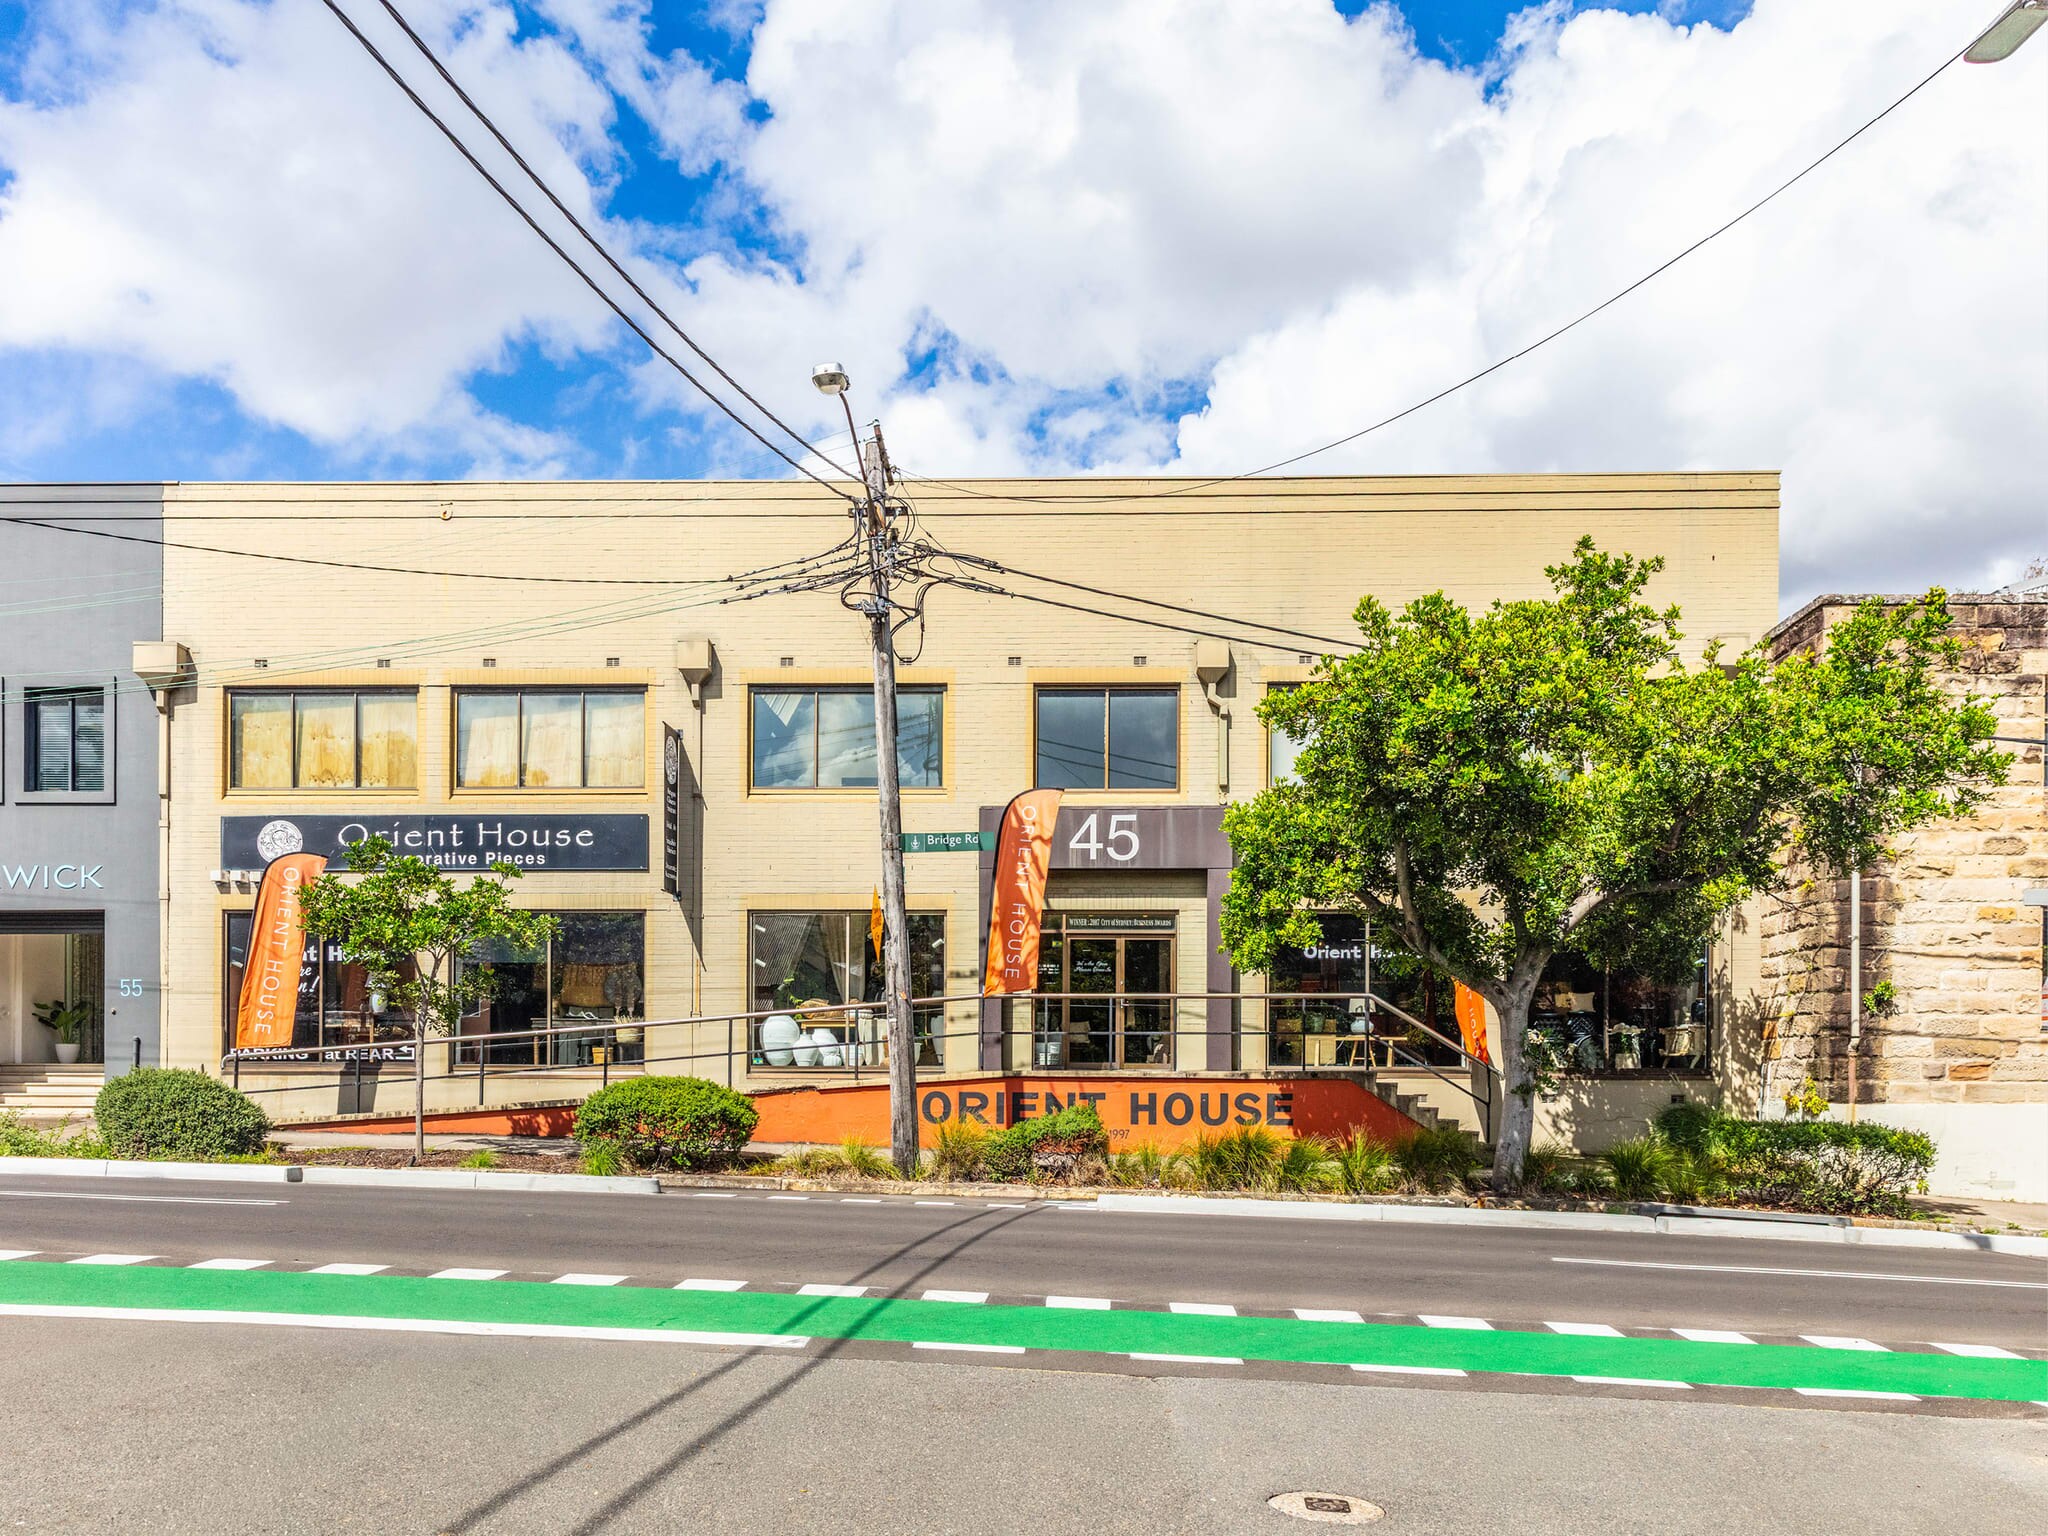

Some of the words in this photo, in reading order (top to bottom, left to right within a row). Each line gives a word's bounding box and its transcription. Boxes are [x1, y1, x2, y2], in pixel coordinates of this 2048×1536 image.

[338, 821, 464, 847] Orient
[478, 822, 594, 847] House
[927, 834, 962, 847] Bridge
[965, 833, 979, 844] Rd
[1069, 814, 1140, 861] 45
[485, 852, 546, 865] Pieces
[1015, 805, 1037, 891] ORIENT
[0, 865, 104, 889] WICK
[271, 867, 300, 951] ORIENT
[1005, 903, 1026, 979] HOUSE
[1303, 945, 1362, 959] Orient
[120, 978, 143, 997] 55
[254, 959, 285, 1035] HOUSE
[325, 1048, 341, 1060] at
[345, 1048, 394, 1060] REAR
[1130, 1092, 1294, 1126] HOUSE
